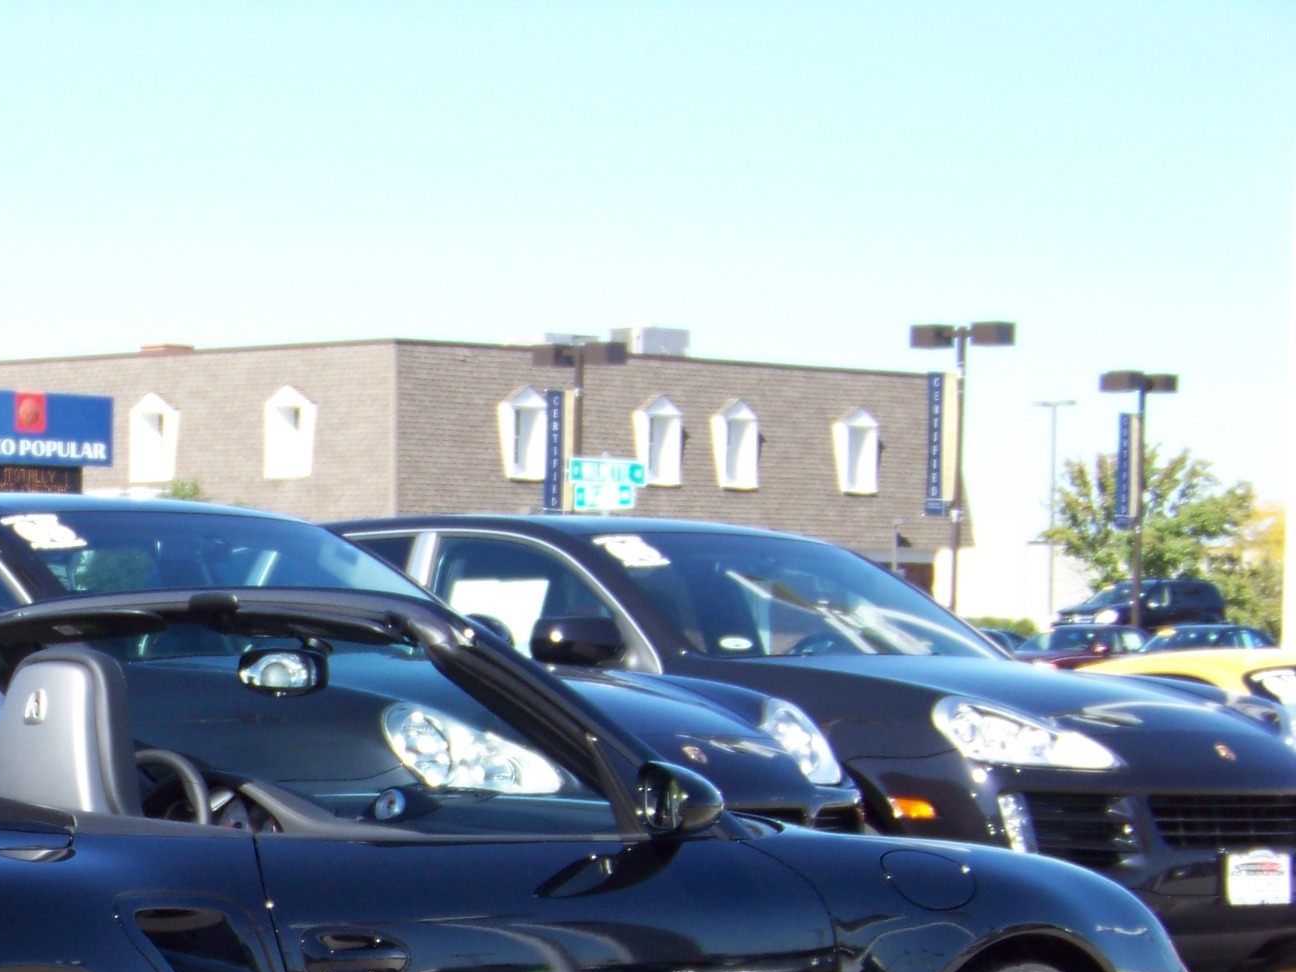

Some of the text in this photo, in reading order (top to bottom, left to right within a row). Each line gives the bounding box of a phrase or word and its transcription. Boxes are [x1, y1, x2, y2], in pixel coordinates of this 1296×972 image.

[19, 438, 107, 460] POPULAR
[551, 396, 560, 507] CERTIFIED
[930, 377, 941, 497] CERTIFIED
